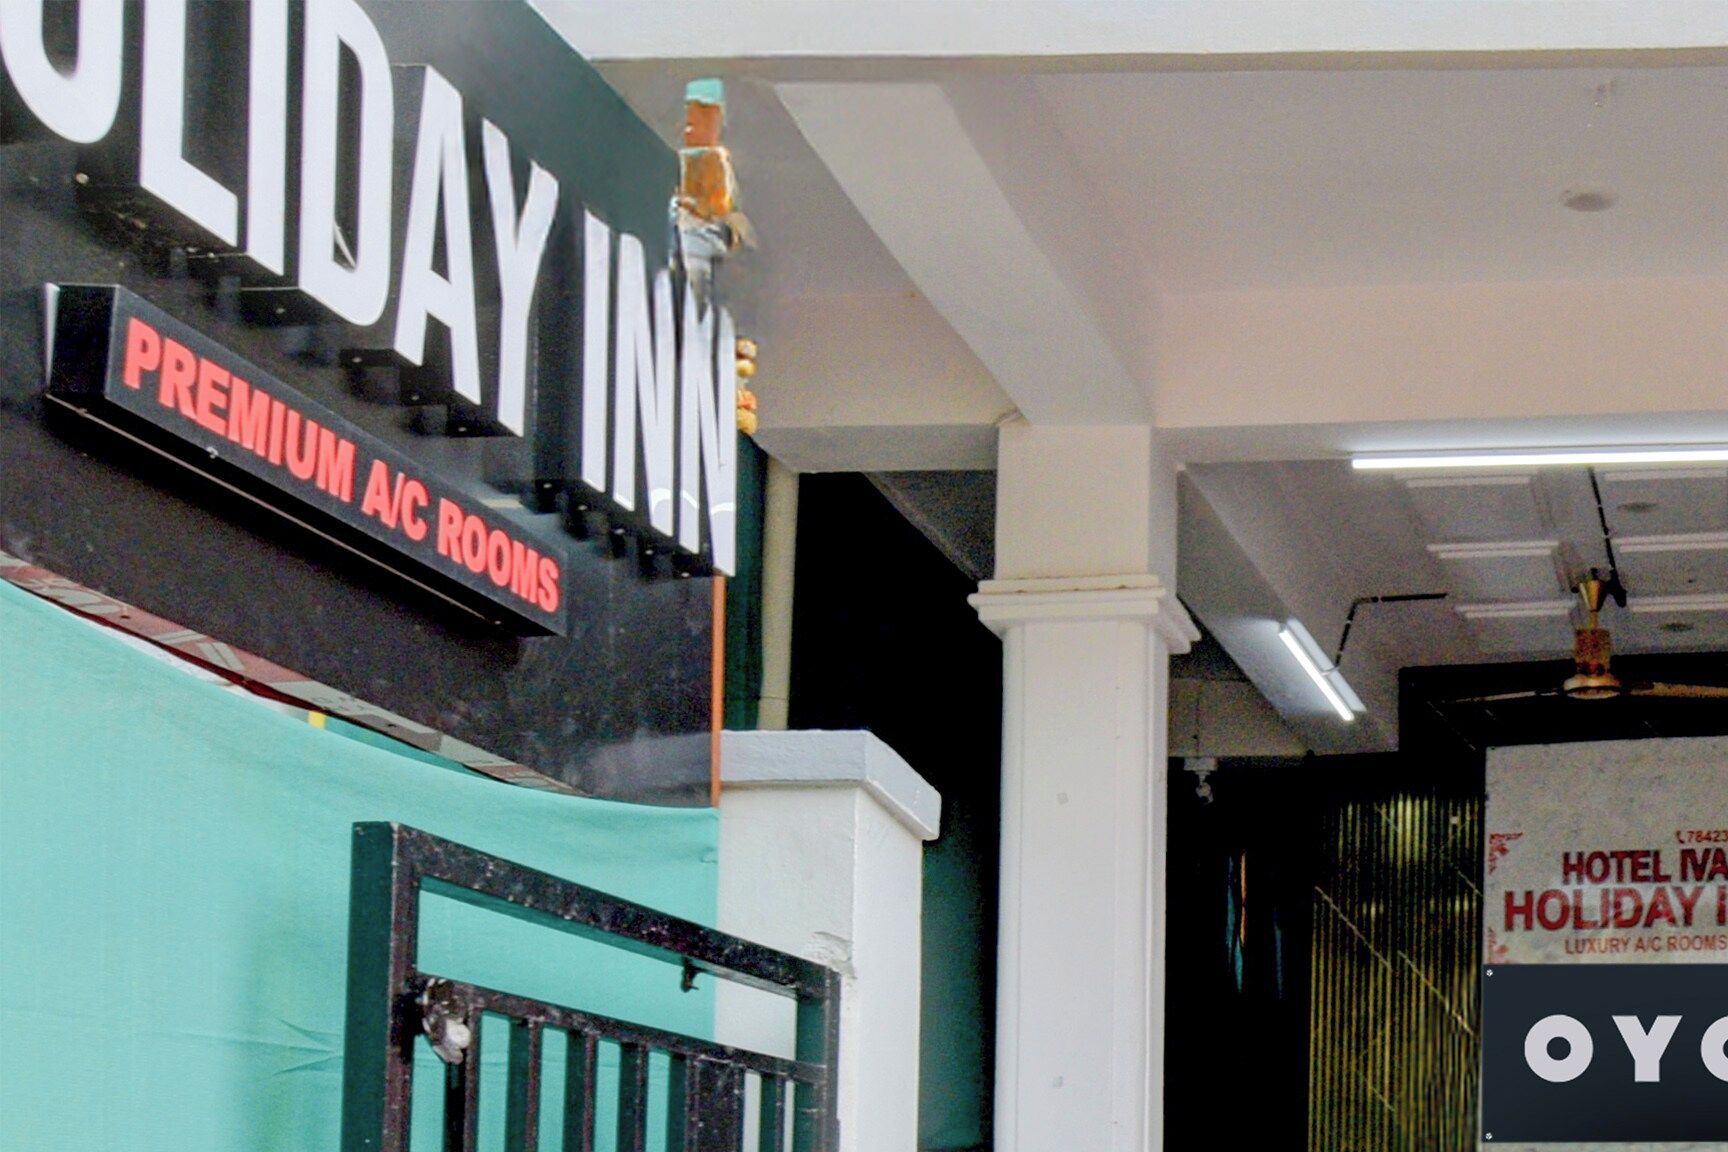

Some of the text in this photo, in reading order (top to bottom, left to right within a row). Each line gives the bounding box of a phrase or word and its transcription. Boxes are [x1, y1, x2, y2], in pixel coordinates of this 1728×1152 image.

[582, 208, 736, 577] INN
[123, 316, 561, 614] PREMIUM A/C ROOMS
[1561, 850, 1671, 885] HOTEL
[1504, 885, 1704, 931] HOLIDAY
[1564, 937, 1631, 954] LUXURY
[1667, 934, 1728, 951] ROOMS
